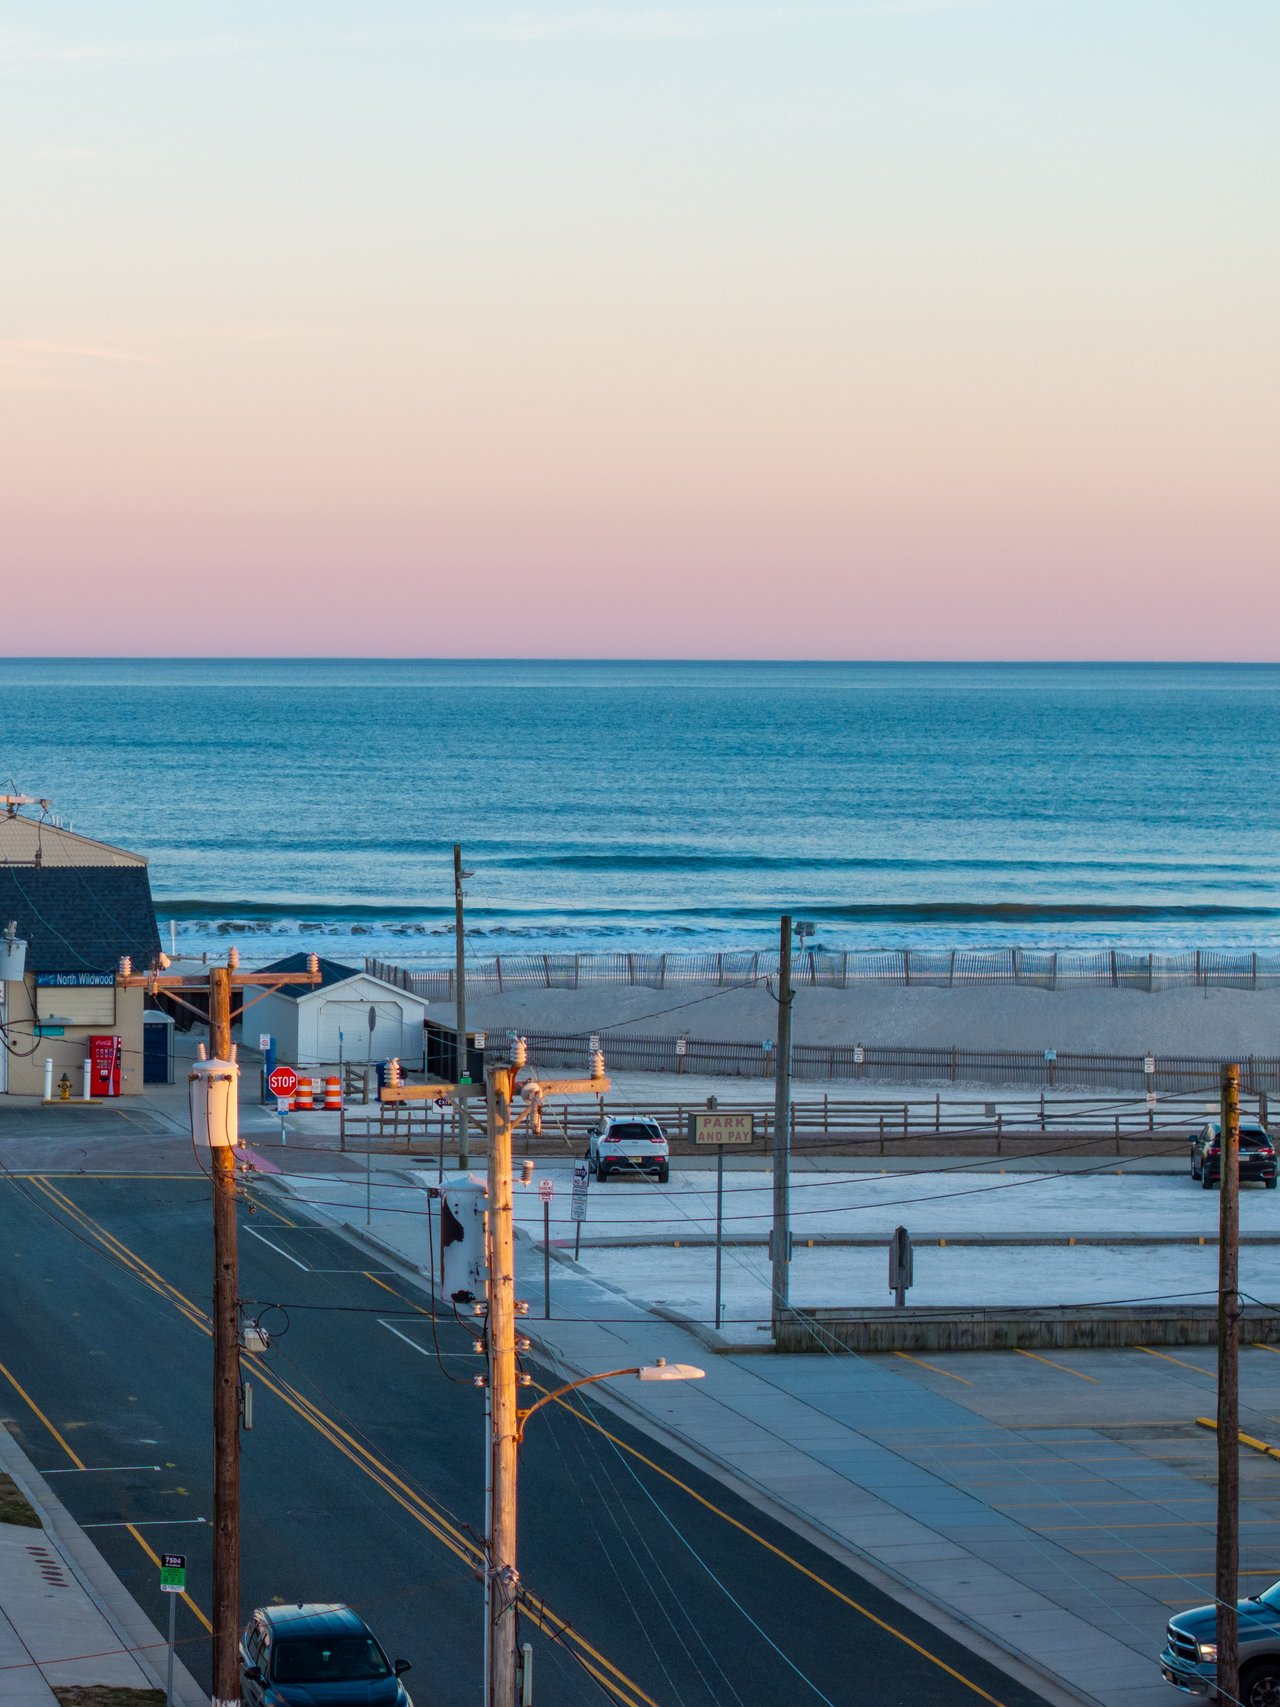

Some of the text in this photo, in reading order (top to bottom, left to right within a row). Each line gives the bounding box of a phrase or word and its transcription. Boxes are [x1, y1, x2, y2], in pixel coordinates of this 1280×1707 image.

[56, 972, 77, 985] North
[79, 972, 114, 985] Wildwood
[271, 1076, 296, 1088] STOP
[703, 1117, 745, 1128] PARK
[698, 1131, 750, 1142] AND PAY
